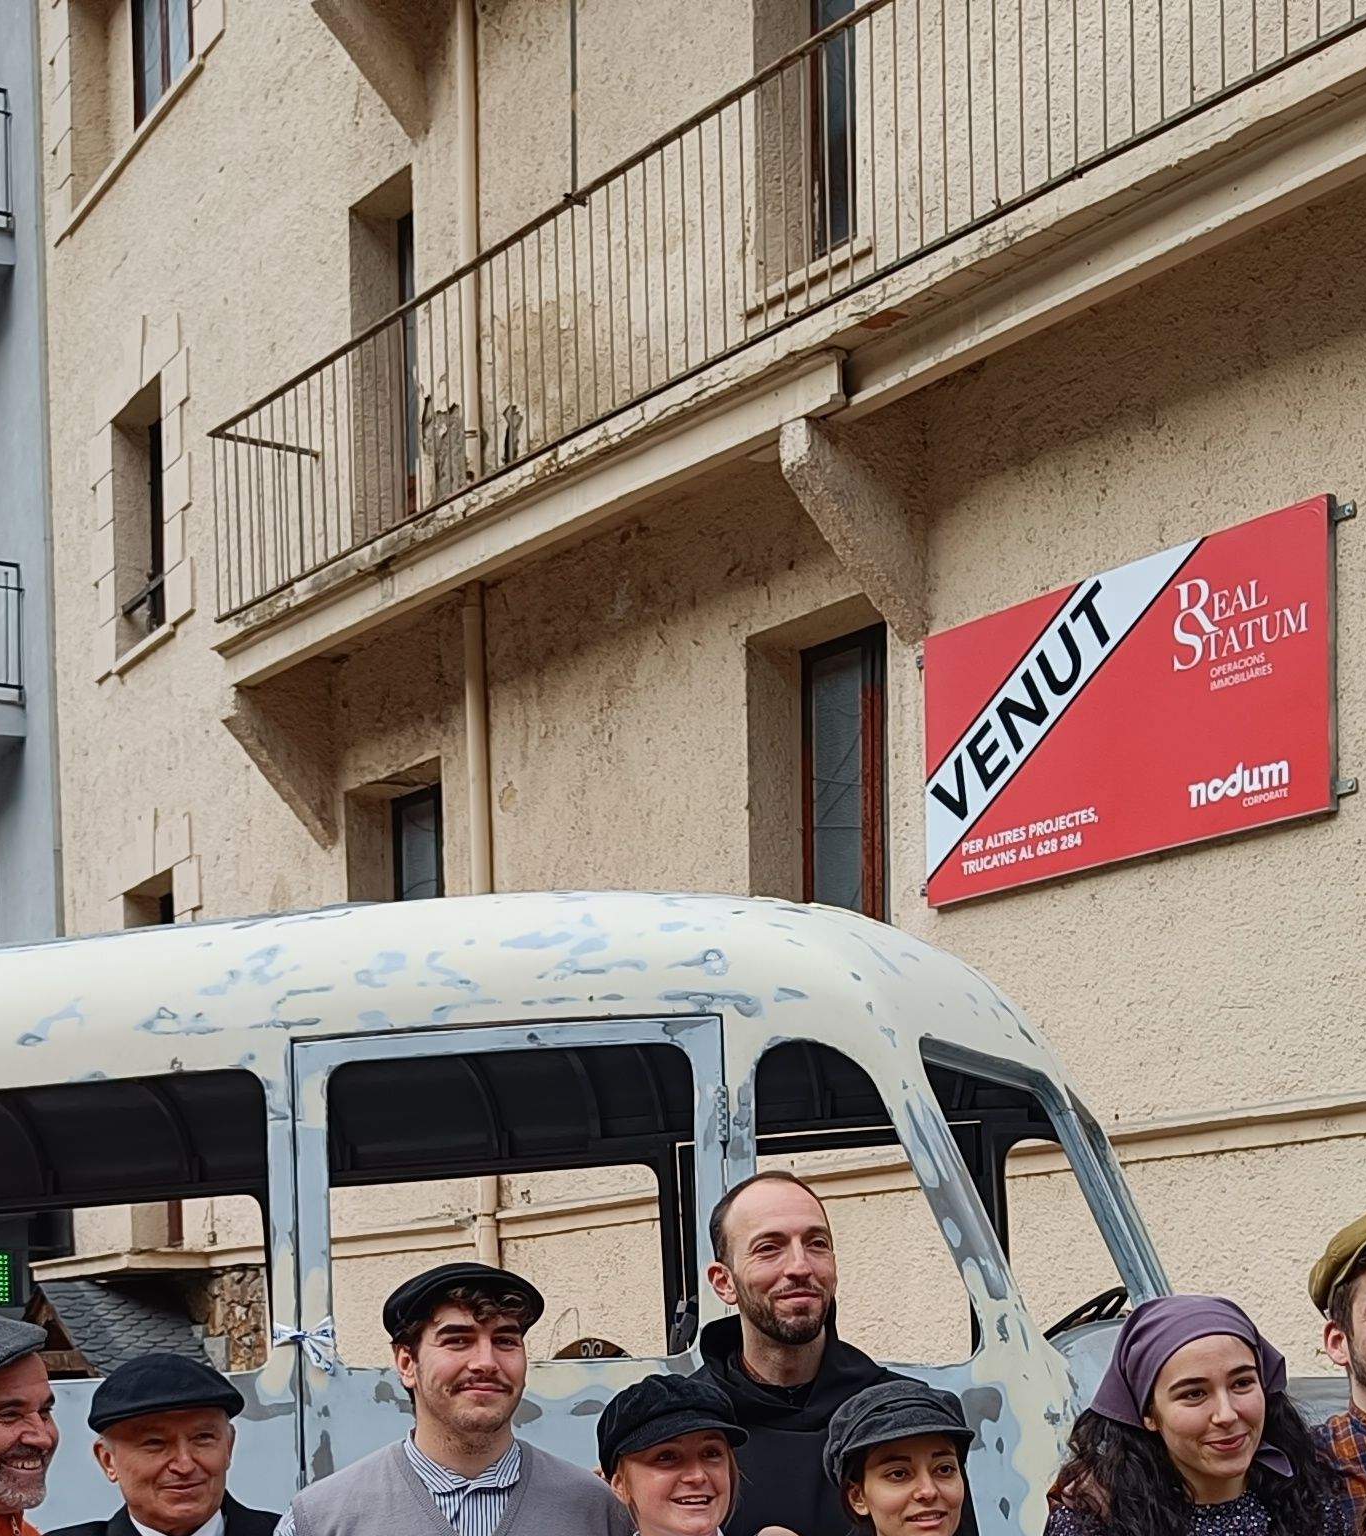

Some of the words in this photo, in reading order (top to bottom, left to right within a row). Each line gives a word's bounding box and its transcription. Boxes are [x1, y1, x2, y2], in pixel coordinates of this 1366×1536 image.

[1174, 578, 1268, 634] REAL
[1172, 601, 1310, 672] STATUM
[1209, 652, 1266, 679] OPERACIONS
[929, 579, 1111, 822] VENUT
[1188, 760, 1290, 808] nodum
[1242, 788, 1289, 808] CORPORATE
[961, 836, 984, 857] PER
[985, 826, 1027, 851] ALTRES
[1018, 845, 1035, 861] AL
[1036, 837, 1058, 857] 628
[1060, 831, 1083, 851] 284
